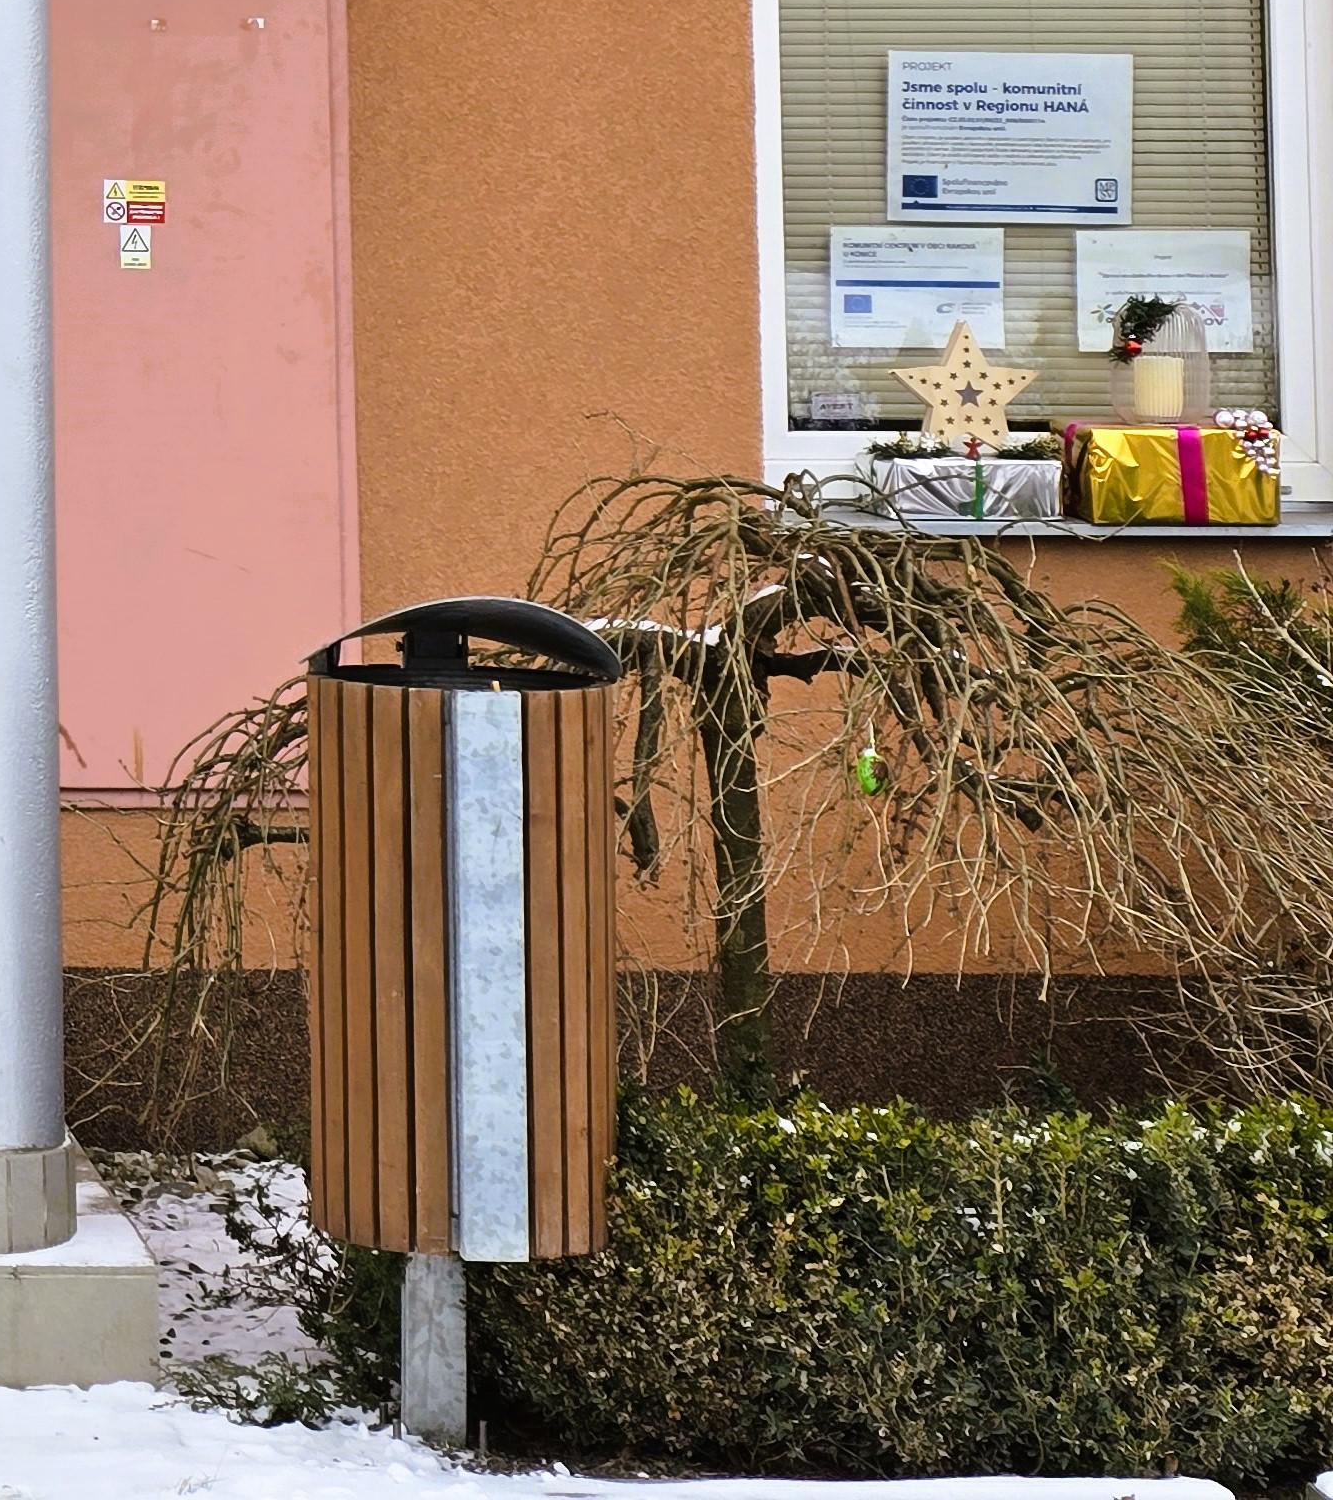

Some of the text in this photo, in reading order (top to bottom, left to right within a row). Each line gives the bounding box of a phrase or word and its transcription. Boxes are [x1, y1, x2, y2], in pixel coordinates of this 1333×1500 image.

[902, 61, 953, 71] PROJEKT
[901, 81, 942, 93] Jsme
[946, 81, 988, 96] spolu
[1002, 82, 1082, 96] komunitní
[901, 98, 1090, 114] činnost v Regionu HANÁ
